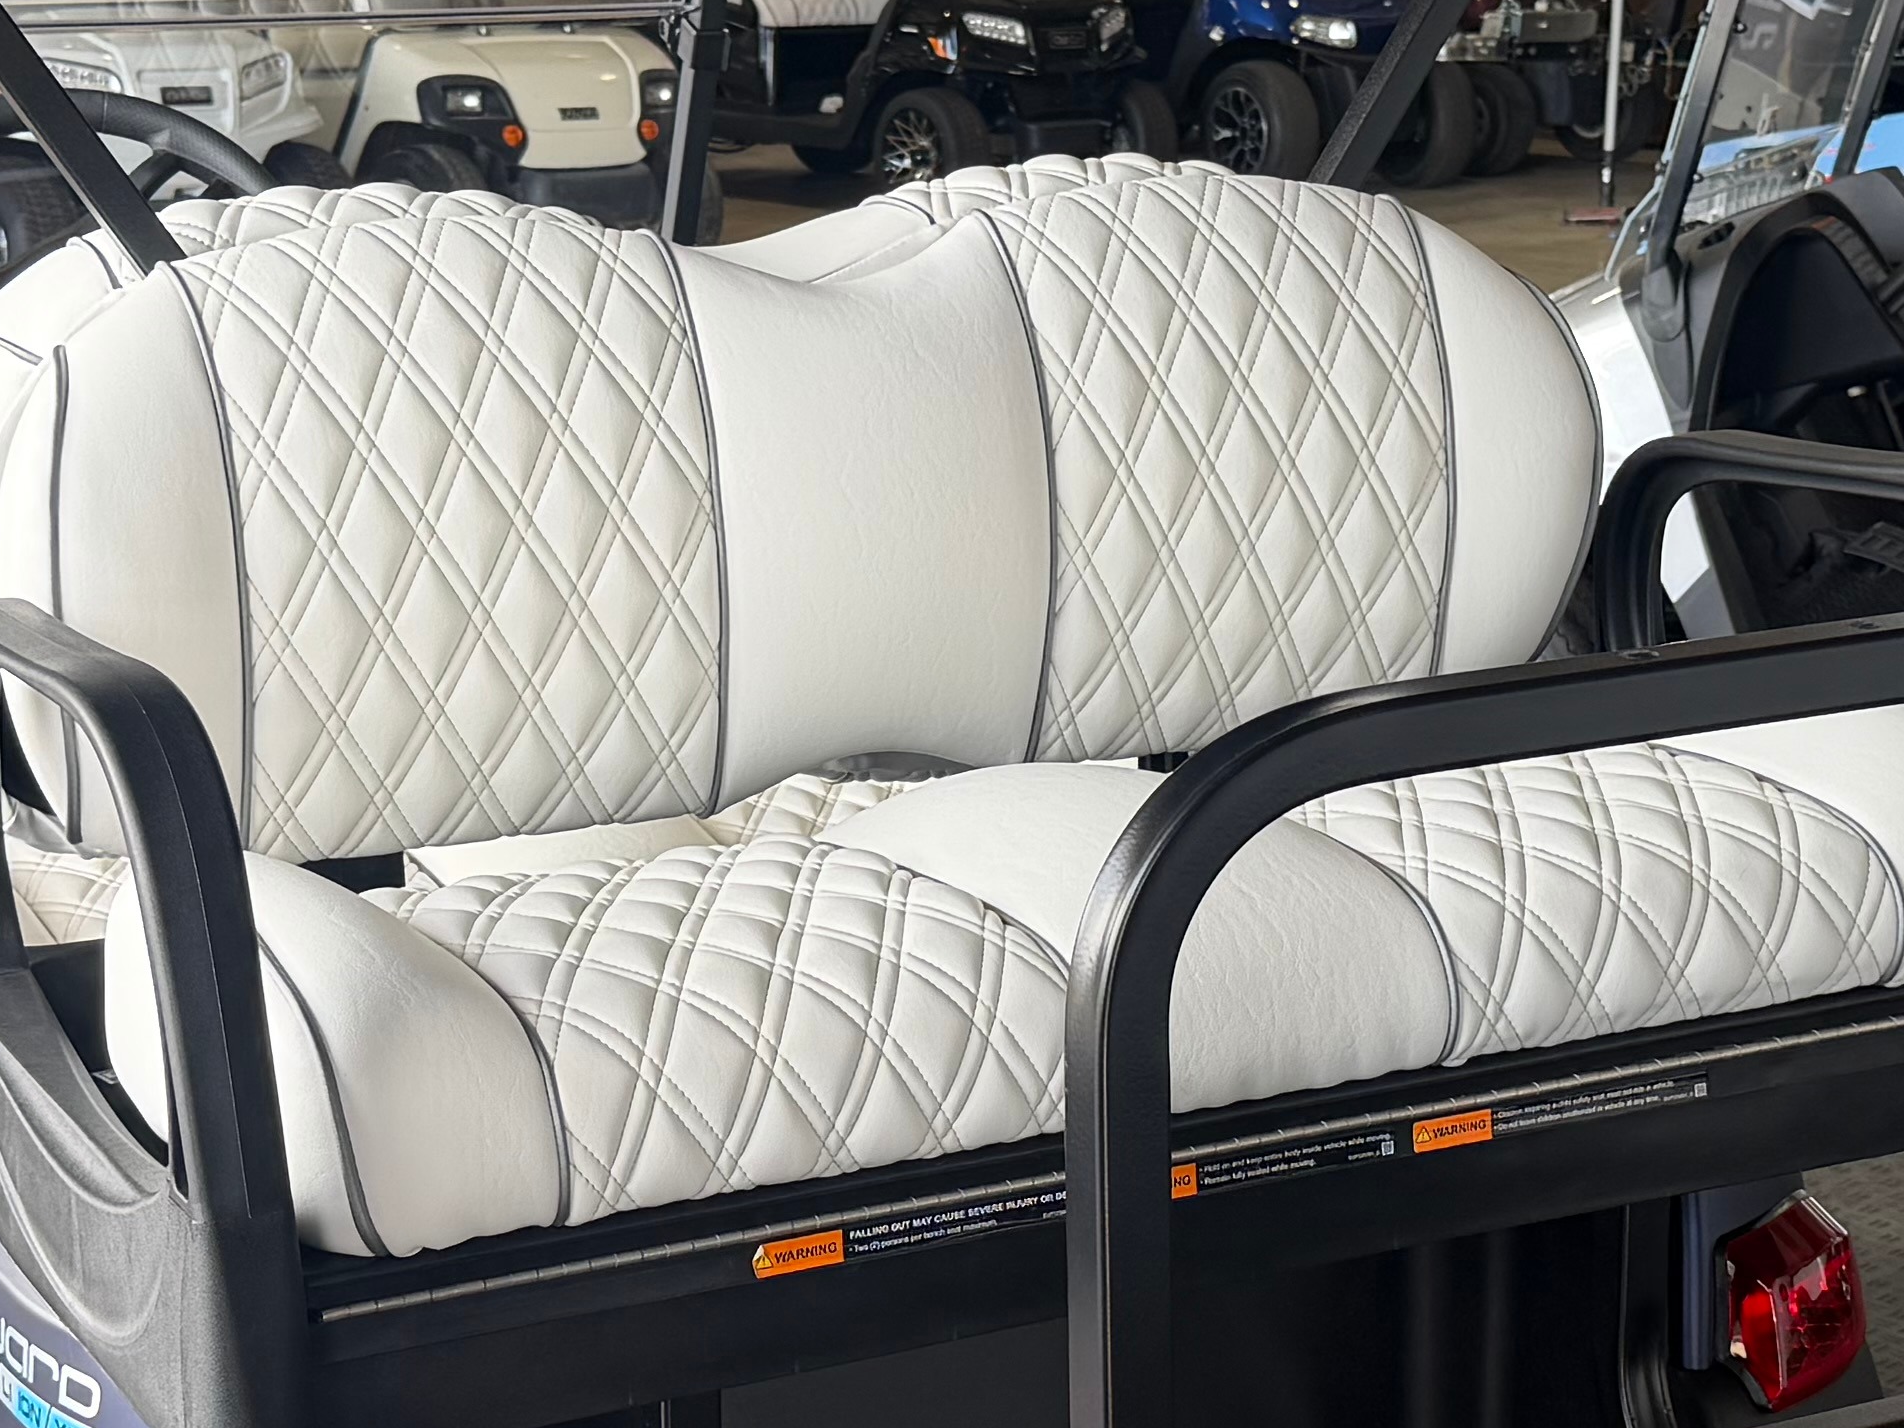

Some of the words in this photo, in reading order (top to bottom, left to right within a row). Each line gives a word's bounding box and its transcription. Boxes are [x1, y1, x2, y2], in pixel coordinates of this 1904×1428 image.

[1431, 1119, 1487, 1139] WARNING
[848, 1224, 890, 1240] FALLING
[890, 1219, 912, 1233] OUT
[911, 1215, 934, 1228] MAY
[933, 1208, 966, 1224] CAUSE
[967, 1202, 1005, 1217] SEVERE
[1039, 1193, 1054, 1204] OR
[773, 1241, 838, 1265] WARNING
